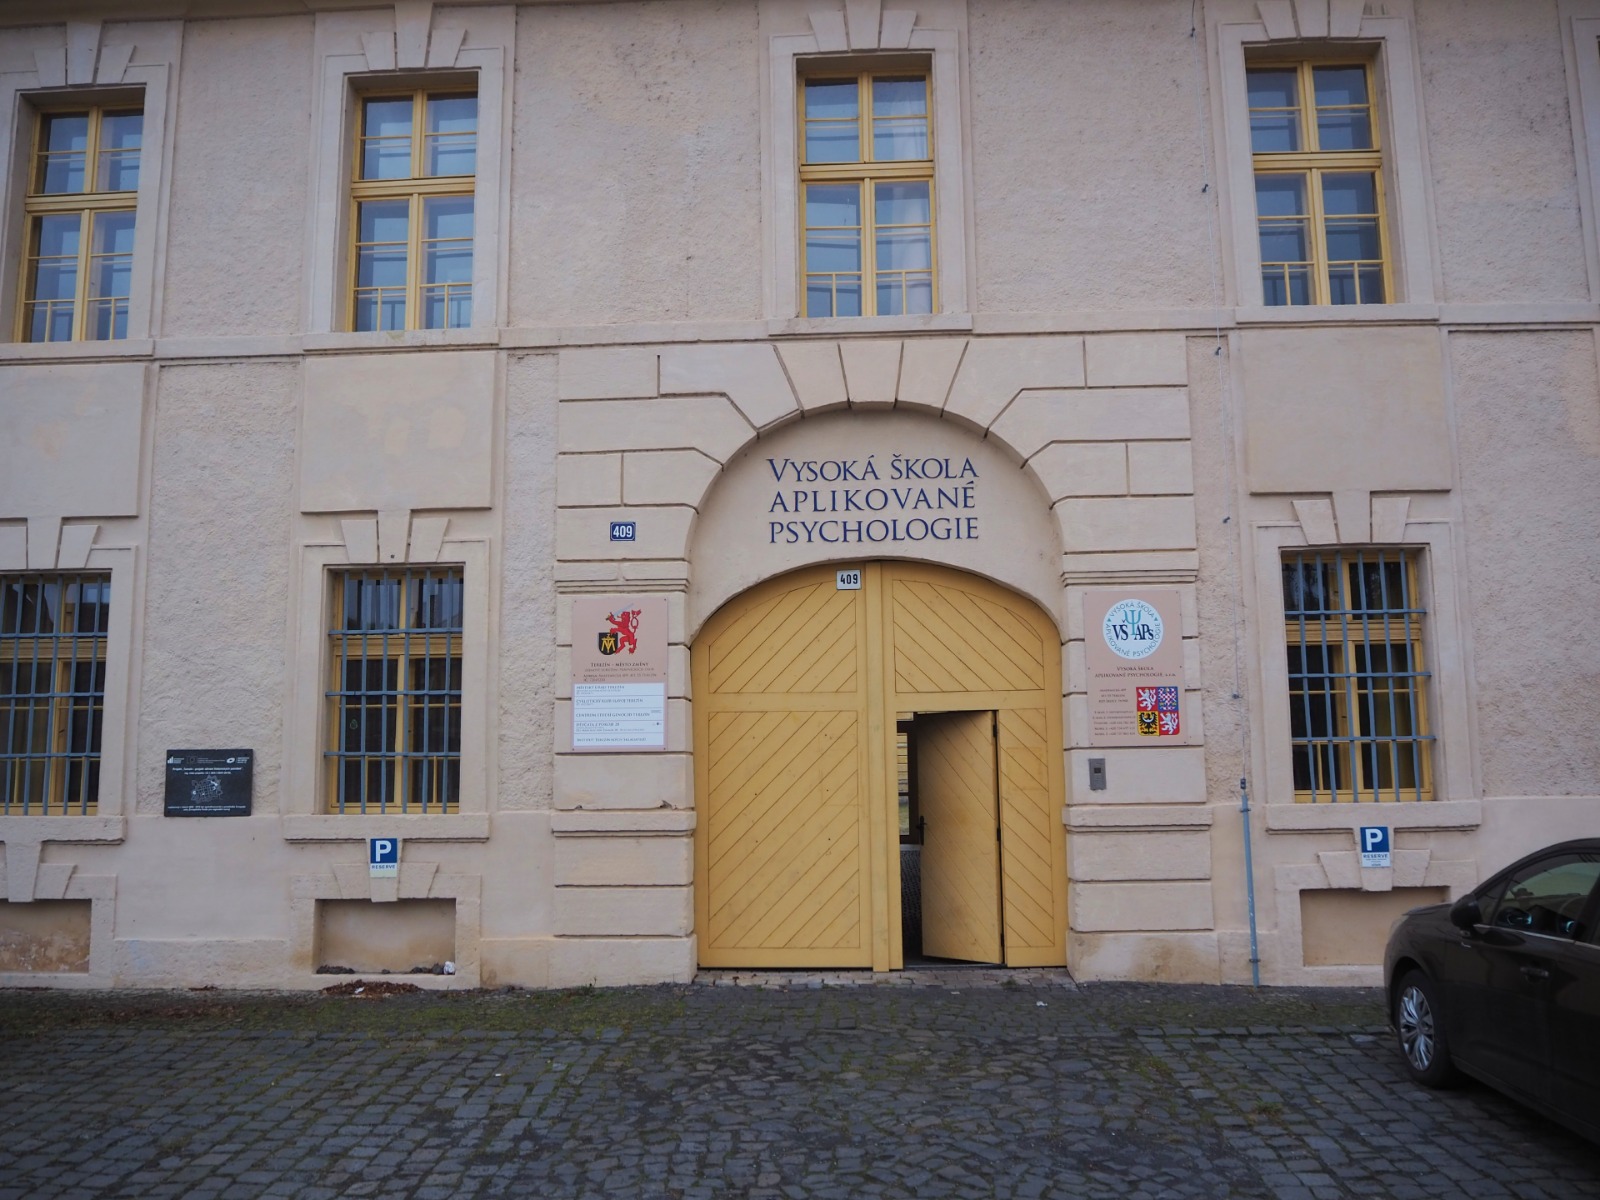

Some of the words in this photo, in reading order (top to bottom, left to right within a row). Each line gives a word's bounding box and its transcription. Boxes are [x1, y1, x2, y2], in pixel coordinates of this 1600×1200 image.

[766, 454, 880, 482] VYSOKÁ
[890, 453, 979, 480] ŠKOLA
[768, 480, 976, 513] APLIKOVANÉ
[613, 525, 632, 538] 409
[769, 517, 979, 544] PSYCHOLOGIE
[840, 573, 858, 585] 409
[1137, 601, 1155, 618] ŠKOLA
[1105, 623, 1131, 657] APLIKOVANÉ
[1132, 623, 1162, 657] PSYCHOLOGIE
[375, 840, 392, 862] P
[1365, 828, 1383, 851] P
